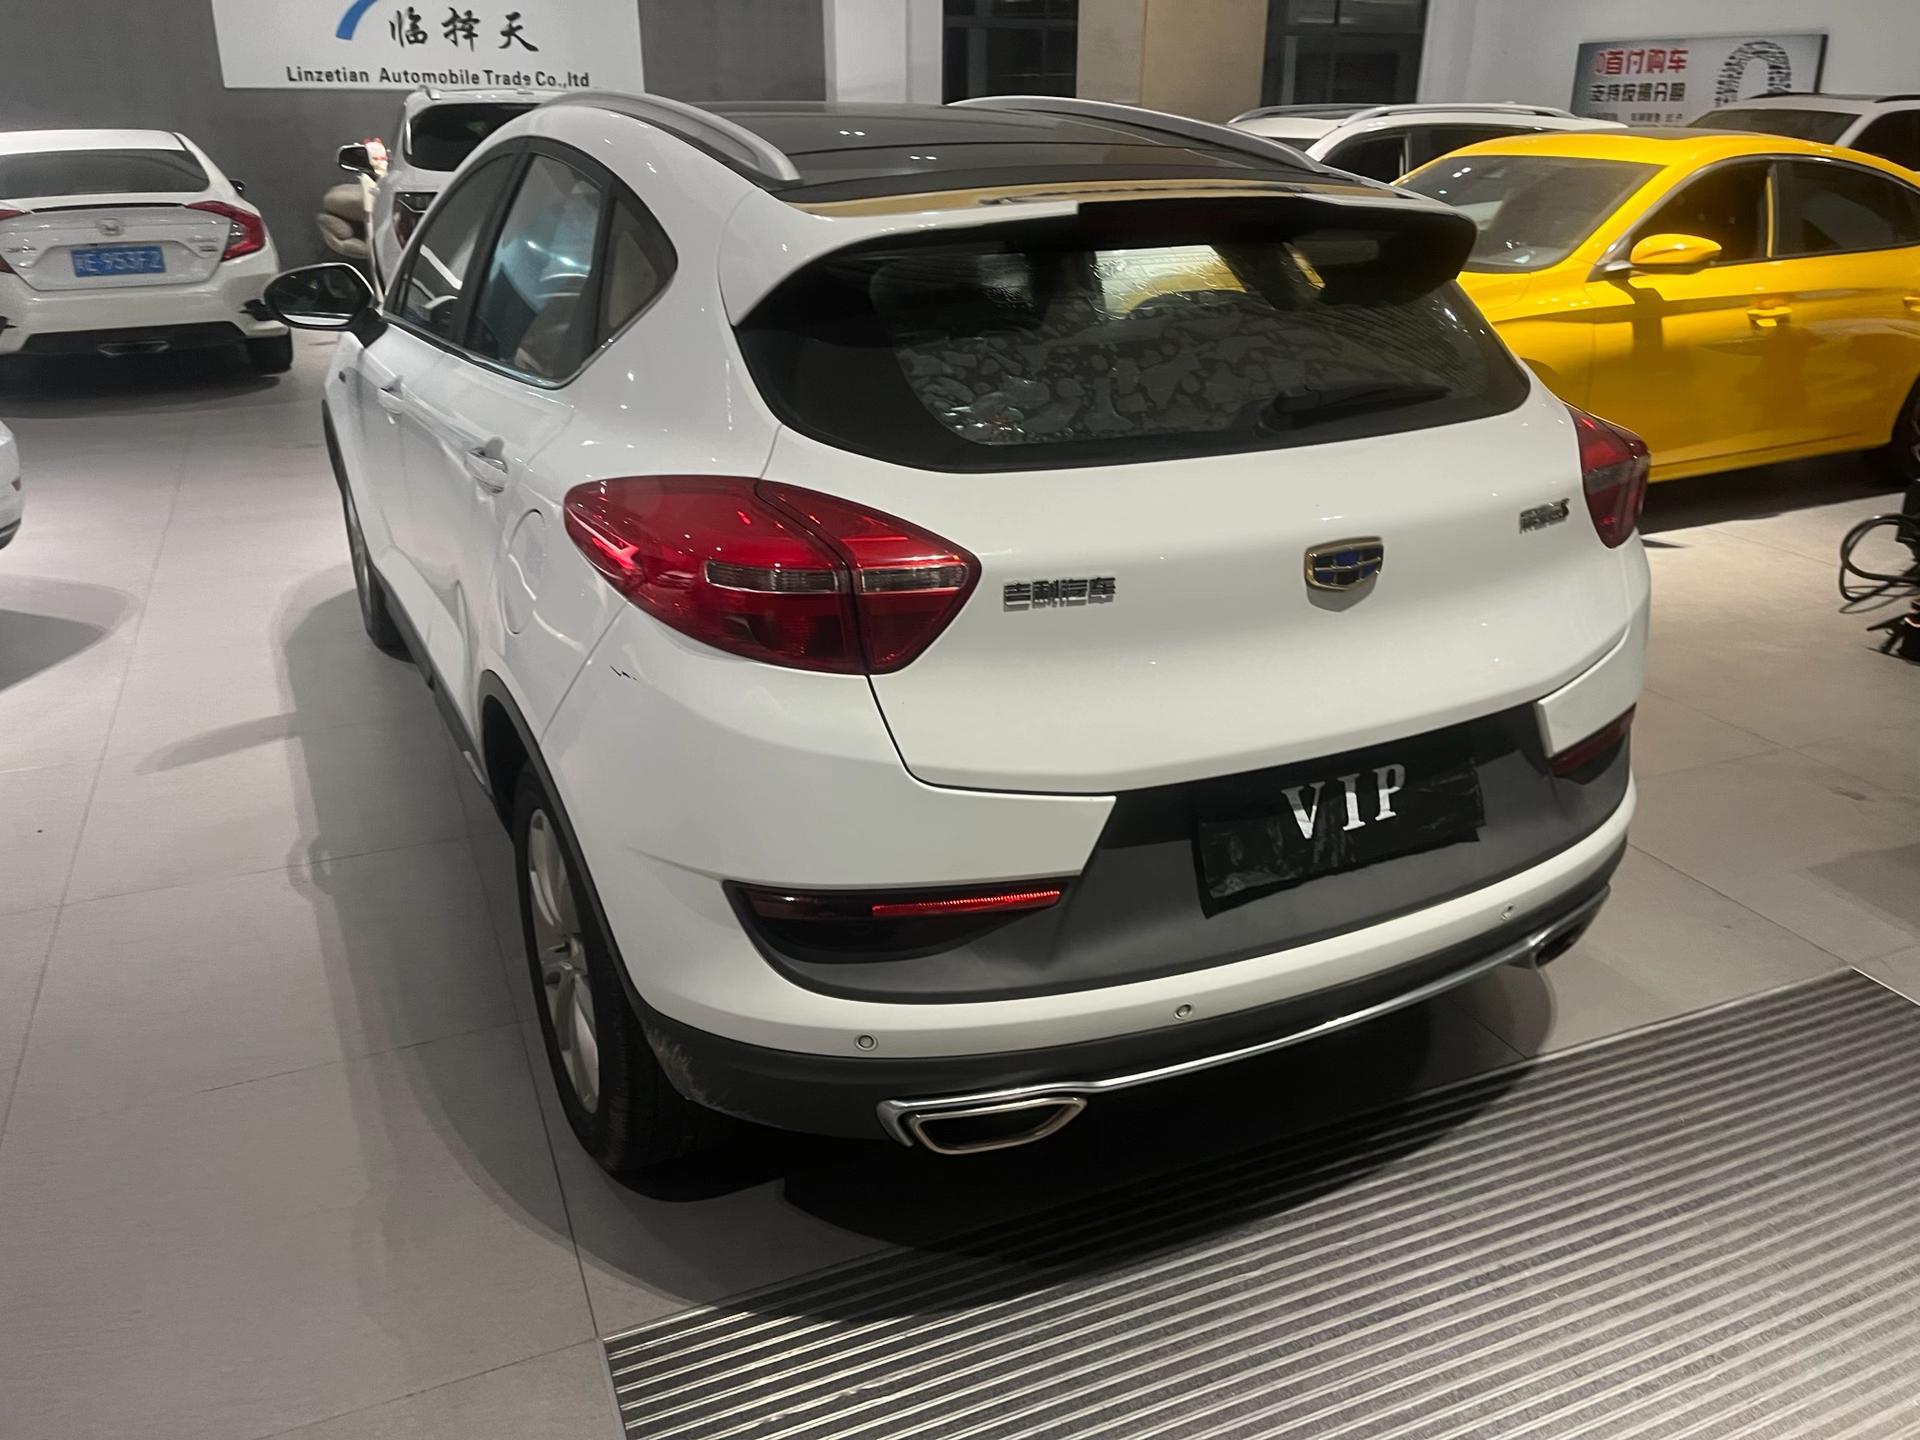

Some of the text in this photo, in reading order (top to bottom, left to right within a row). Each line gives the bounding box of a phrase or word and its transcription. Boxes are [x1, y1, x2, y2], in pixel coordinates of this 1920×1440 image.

[389, 6, 539, 52] 临择天
[286, 65, 370, 84] Linzetian
[379, 67, 480, 85] Automobile
[483, 69, 531, 87] Trade
[1281, 763, 1406, 839] VIP
